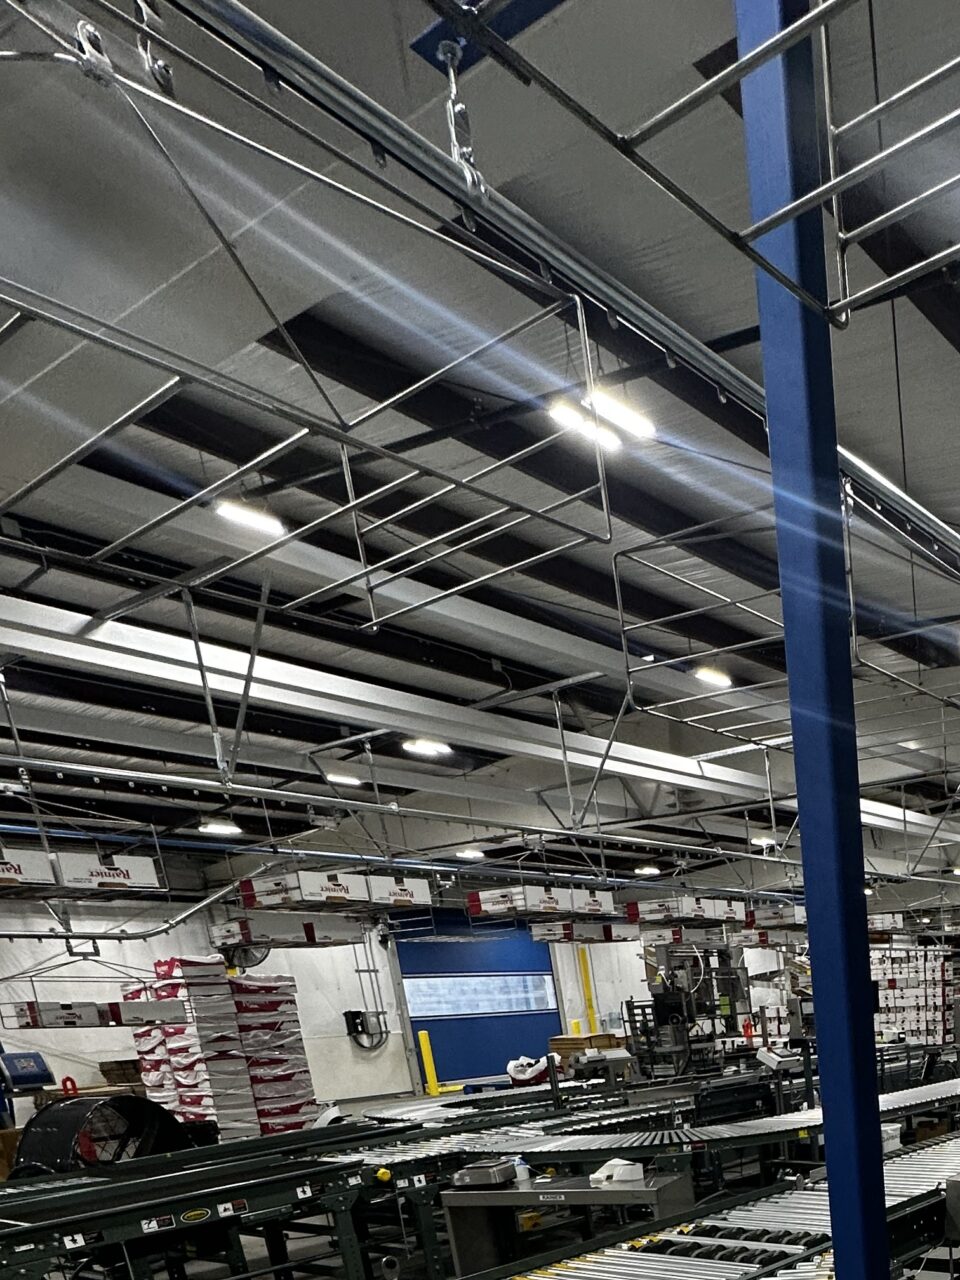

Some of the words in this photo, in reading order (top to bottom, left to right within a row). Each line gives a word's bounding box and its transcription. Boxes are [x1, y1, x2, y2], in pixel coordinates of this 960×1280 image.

[88, 867, 132, 880] Rainier
[320, 885, 350, 895] Rainier
[388, 888, 415, 899] Rainier
